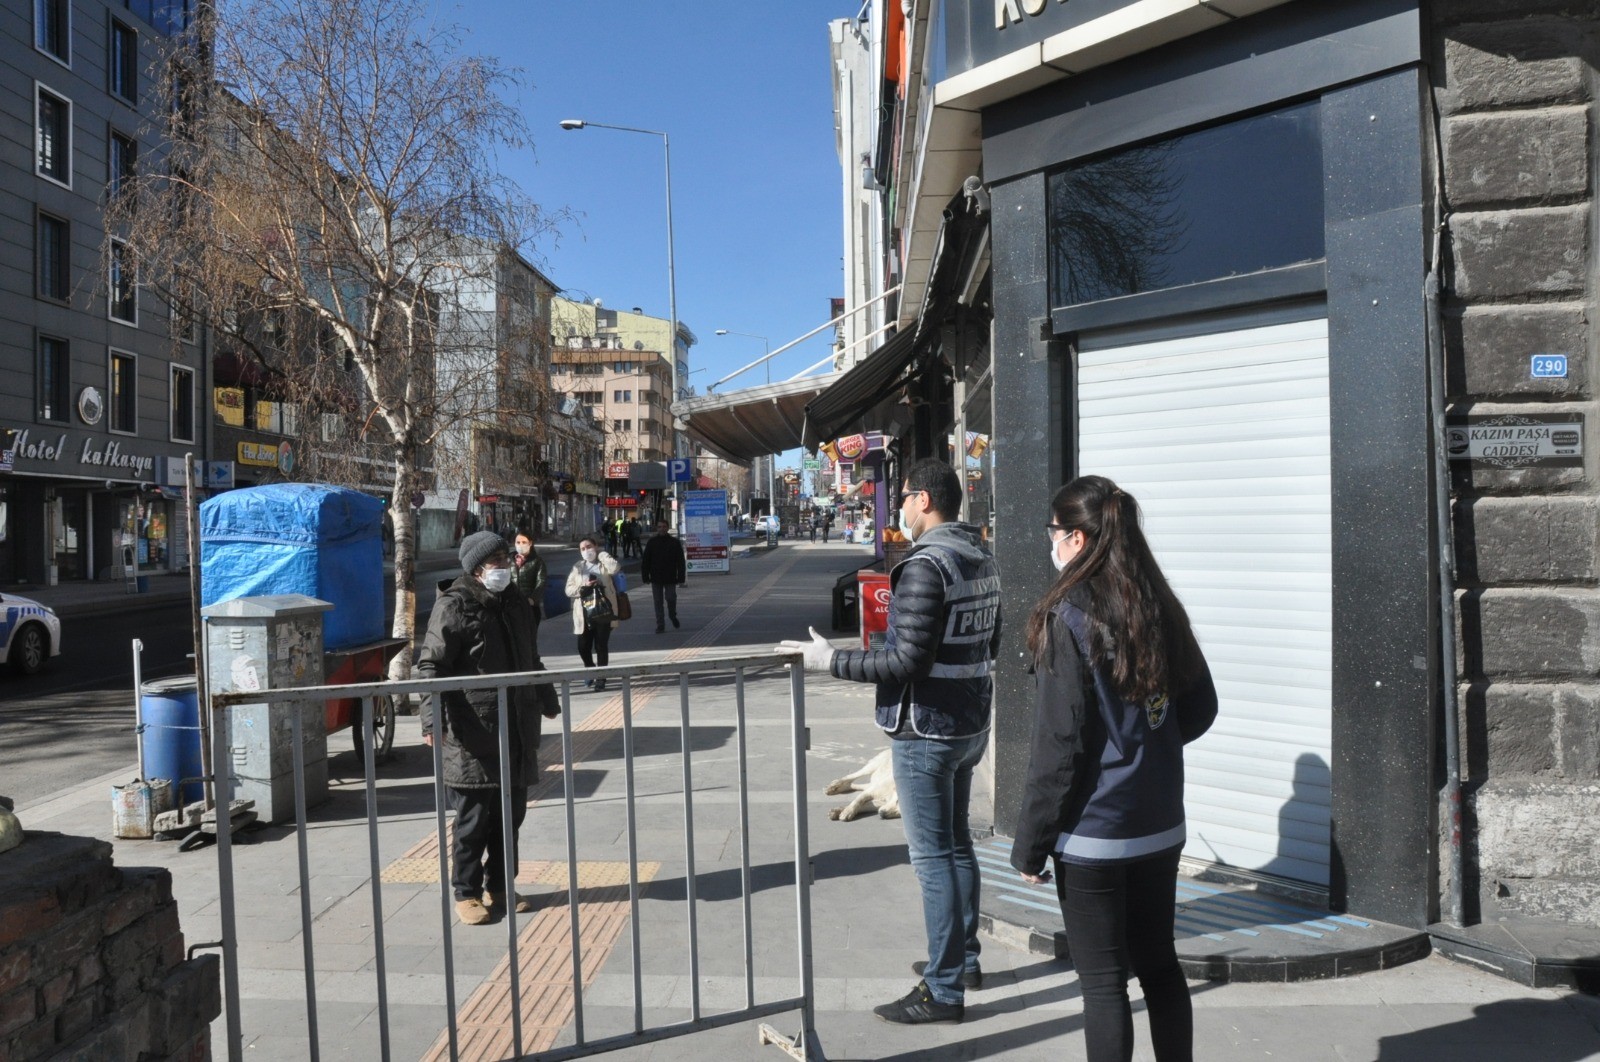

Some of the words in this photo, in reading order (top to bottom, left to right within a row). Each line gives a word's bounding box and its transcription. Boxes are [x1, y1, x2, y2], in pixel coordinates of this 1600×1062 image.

[1536, 361, 1562, 372] 290
[839, 435, 860, 447] BURGER
[1470, 428, 1514, 441] KAZIM
[1516, 428, 1550, 441] PAŞA
[10, 429, 66, 461] Hotel
[841, 440, 862, 454] KING
[1482, 443, 1540, 457] CADDESİ
[671, 460, 686, 480] P
